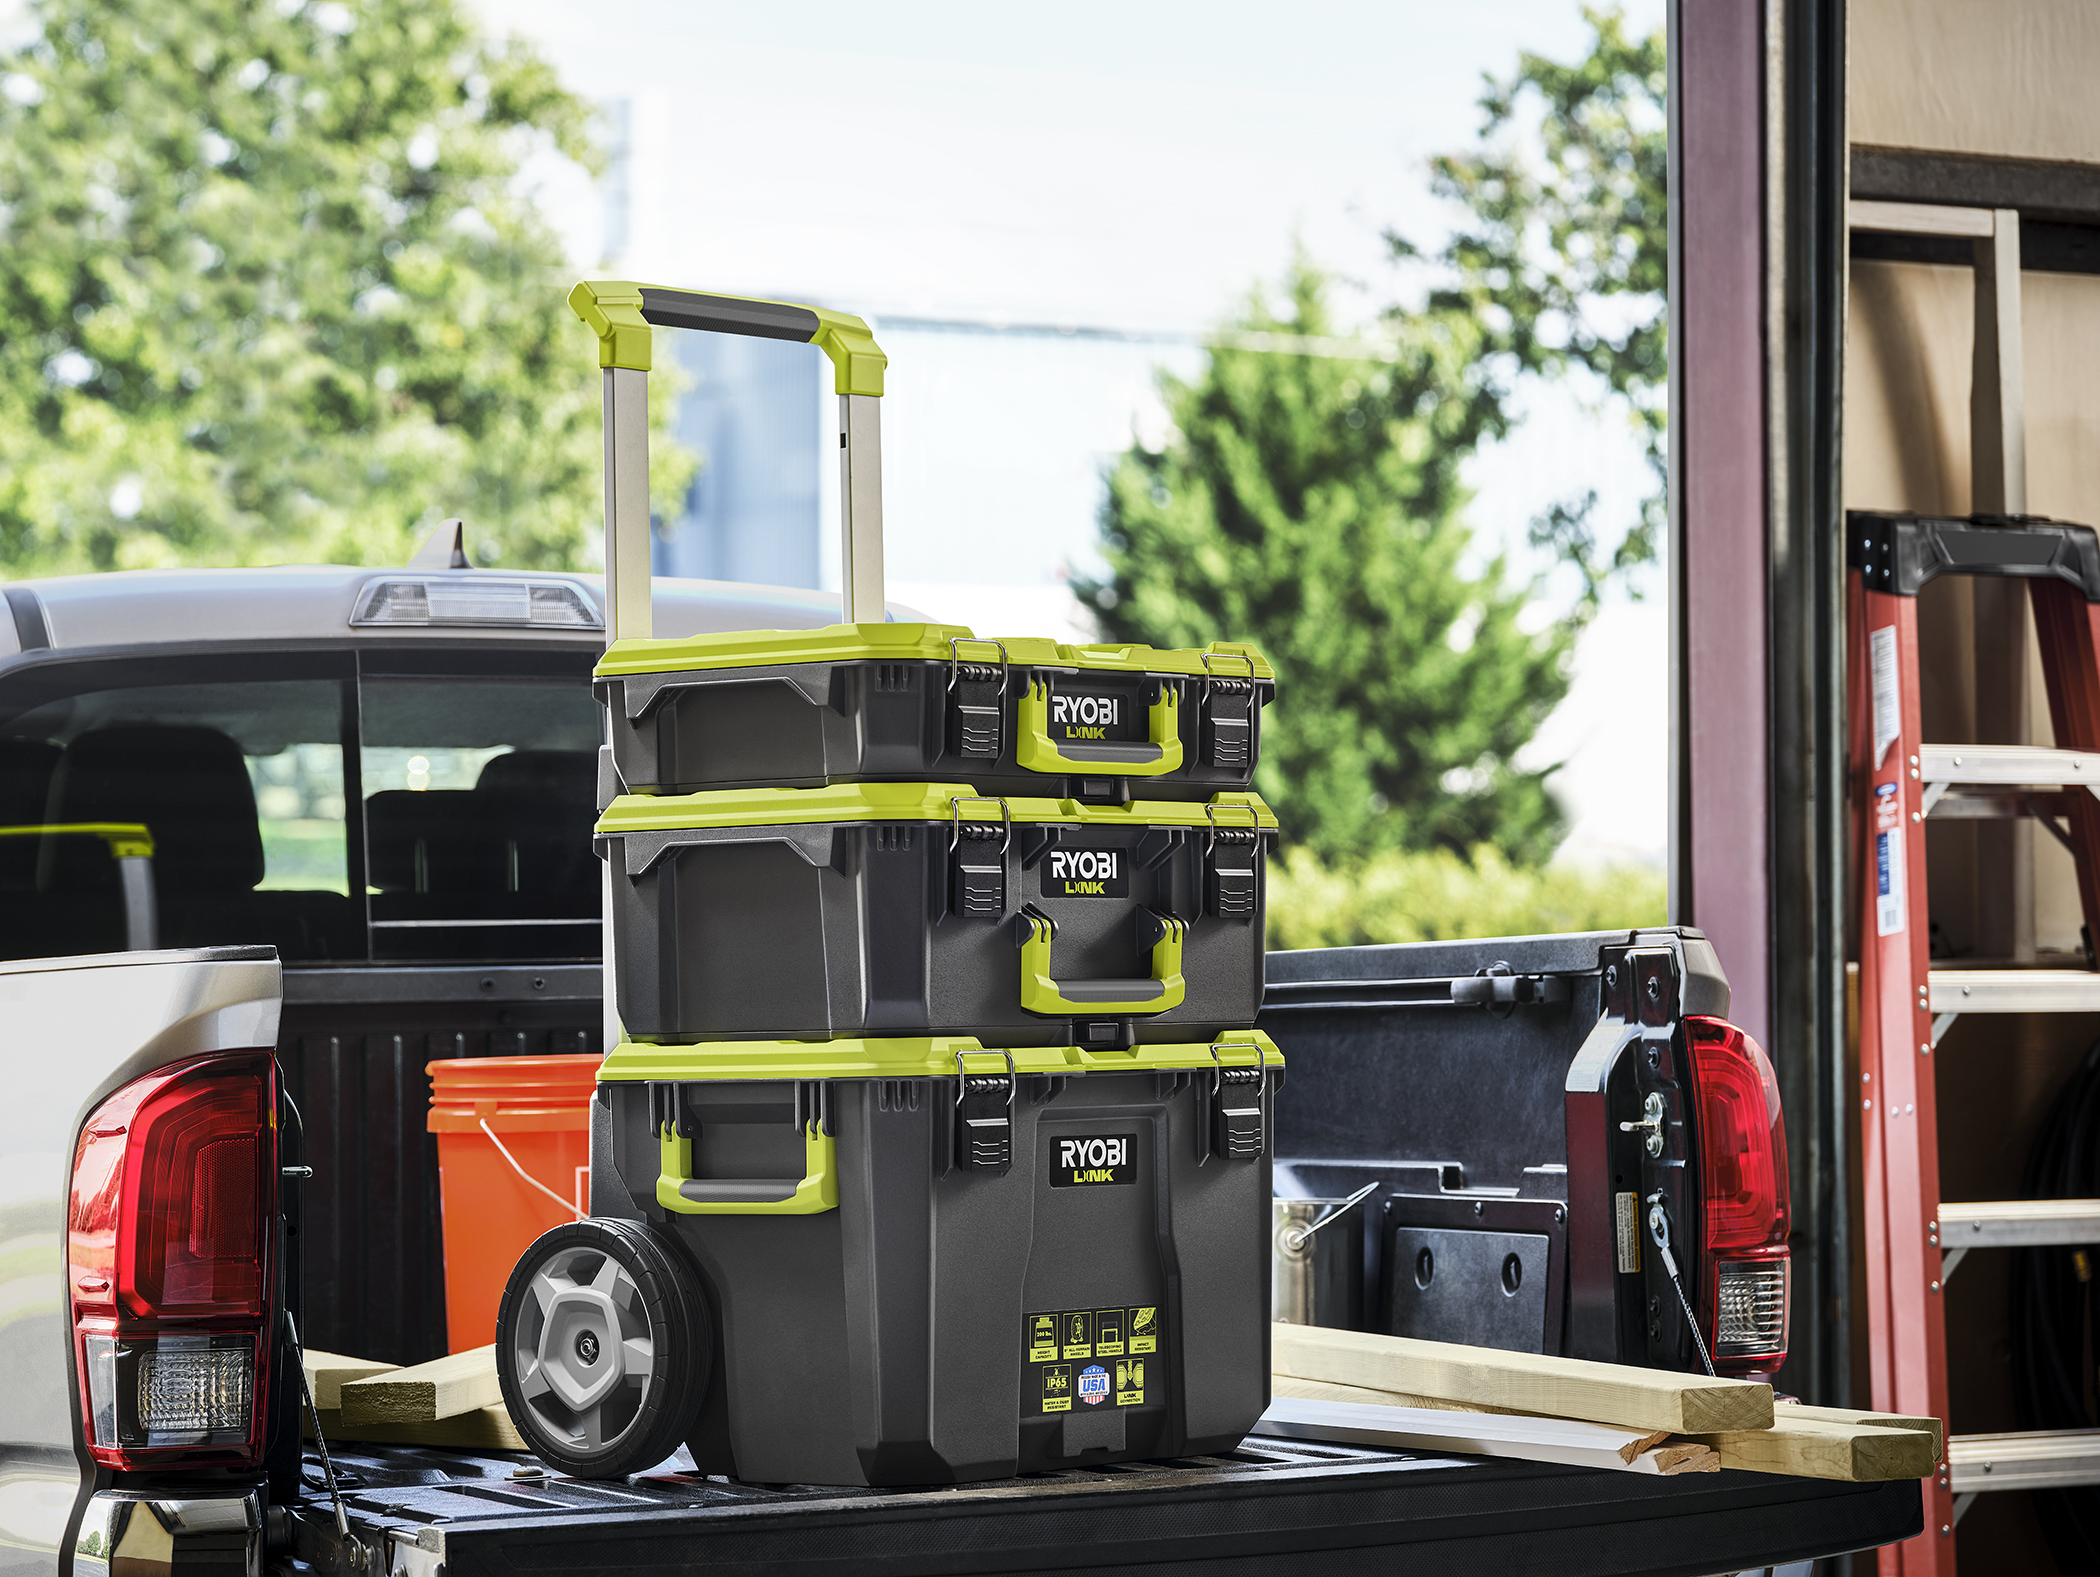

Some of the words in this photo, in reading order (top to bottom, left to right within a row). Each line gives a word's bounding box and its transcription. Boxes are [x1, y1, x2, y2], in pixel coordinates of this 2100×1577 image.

[1052, 695, 1118, 725] RYOBI
[1050, 851, 1117, 879] RYOBI
[1060, 1138, 1127, 1168] RYOBI
[1047, 1377, 1067, 1388] IP65
[1083, 1378, 1105, 1392] USA
